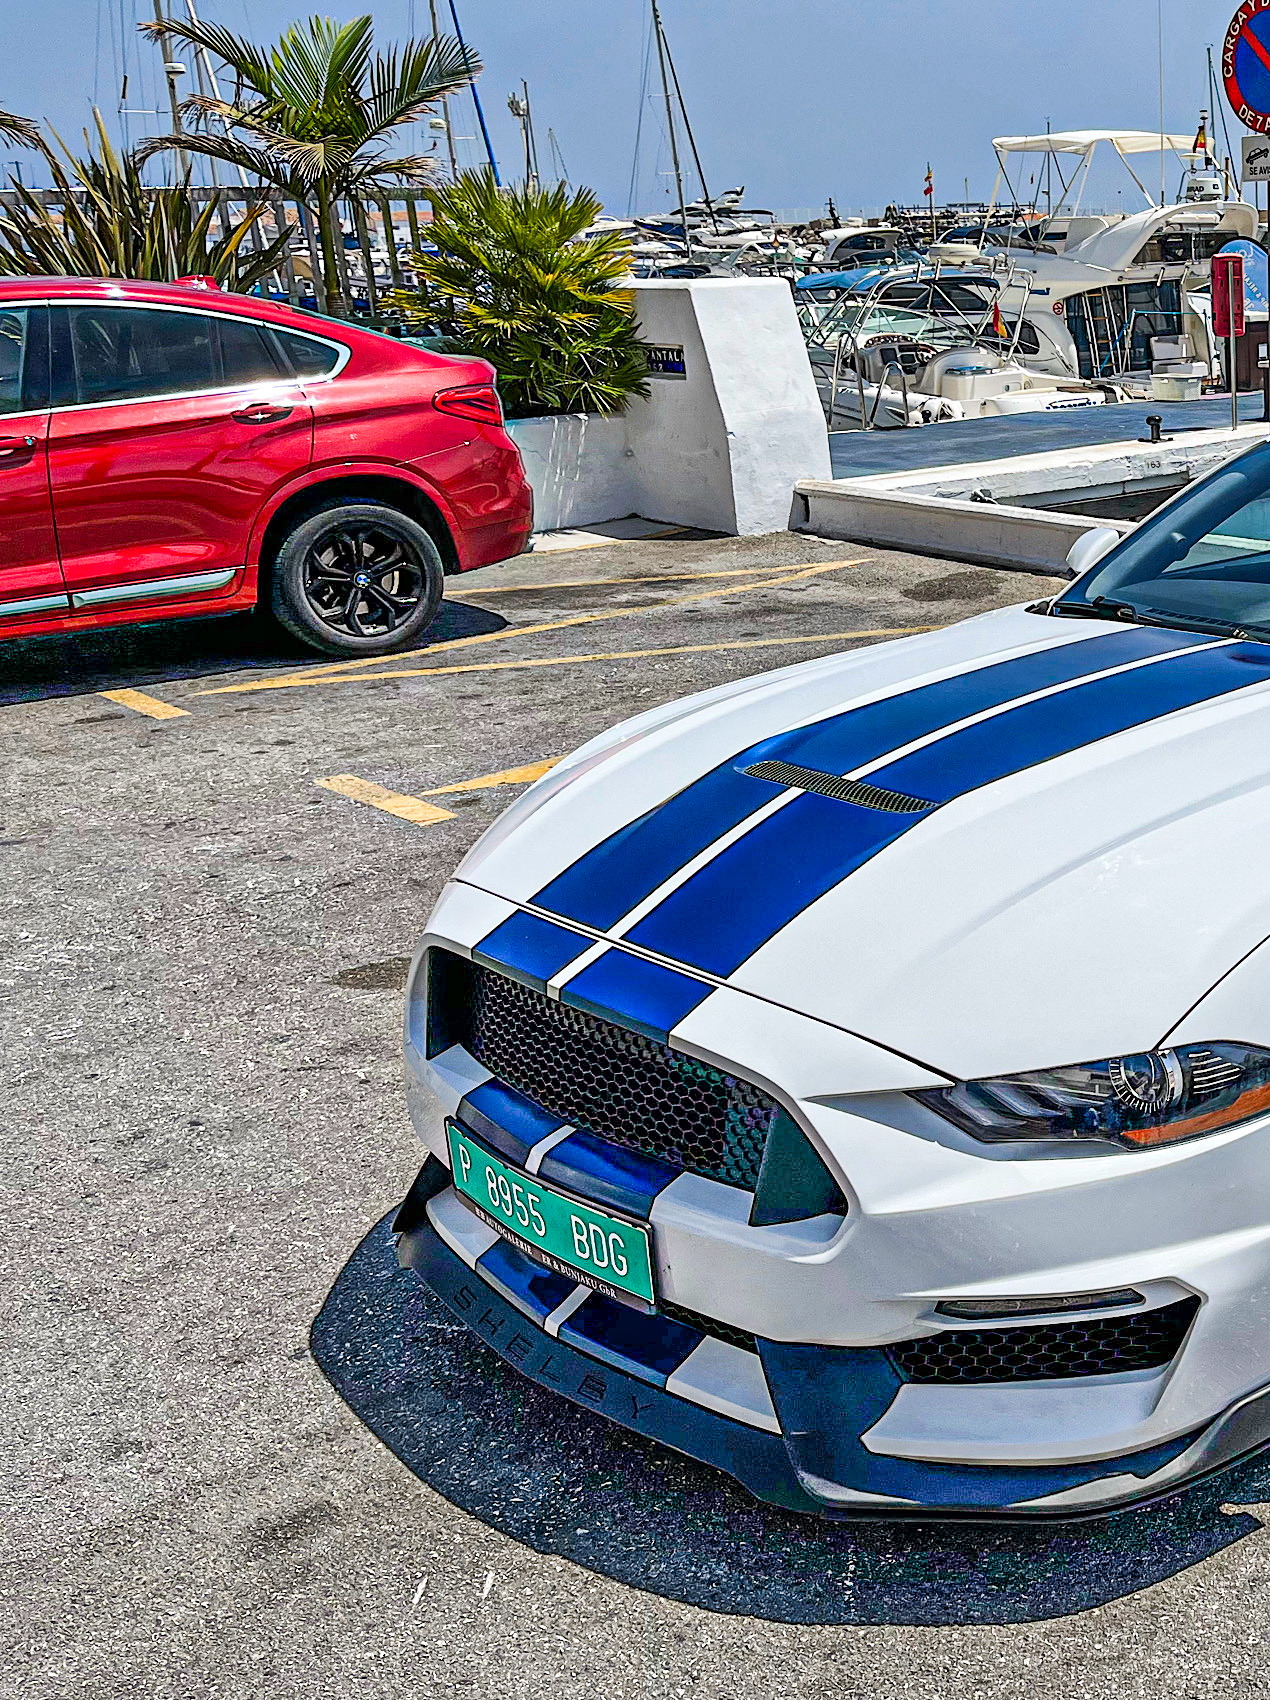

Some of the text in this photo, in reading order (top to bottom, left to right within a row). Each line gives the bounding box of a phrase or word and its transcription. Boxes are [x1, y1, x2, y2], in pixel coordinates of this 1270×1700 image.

[1223, 11, 1248, 78] CARGA
[1250, 0, 1257, 12] Y
[1238, 104, 1254, 126] DE
[1256, 115, 1264, 129] 7
[1249, 166, 1259, 176] SE
[458, 1143, 628, 1277] P 8955 BDG
[485, 1214, 533, 1256] AUTOGALERIE
[560, 1263, 598, 1290] BUNJAKU
[599, 1283, 617, 1299] GbR
[453, 1285, 655, 1420] SHELBY
